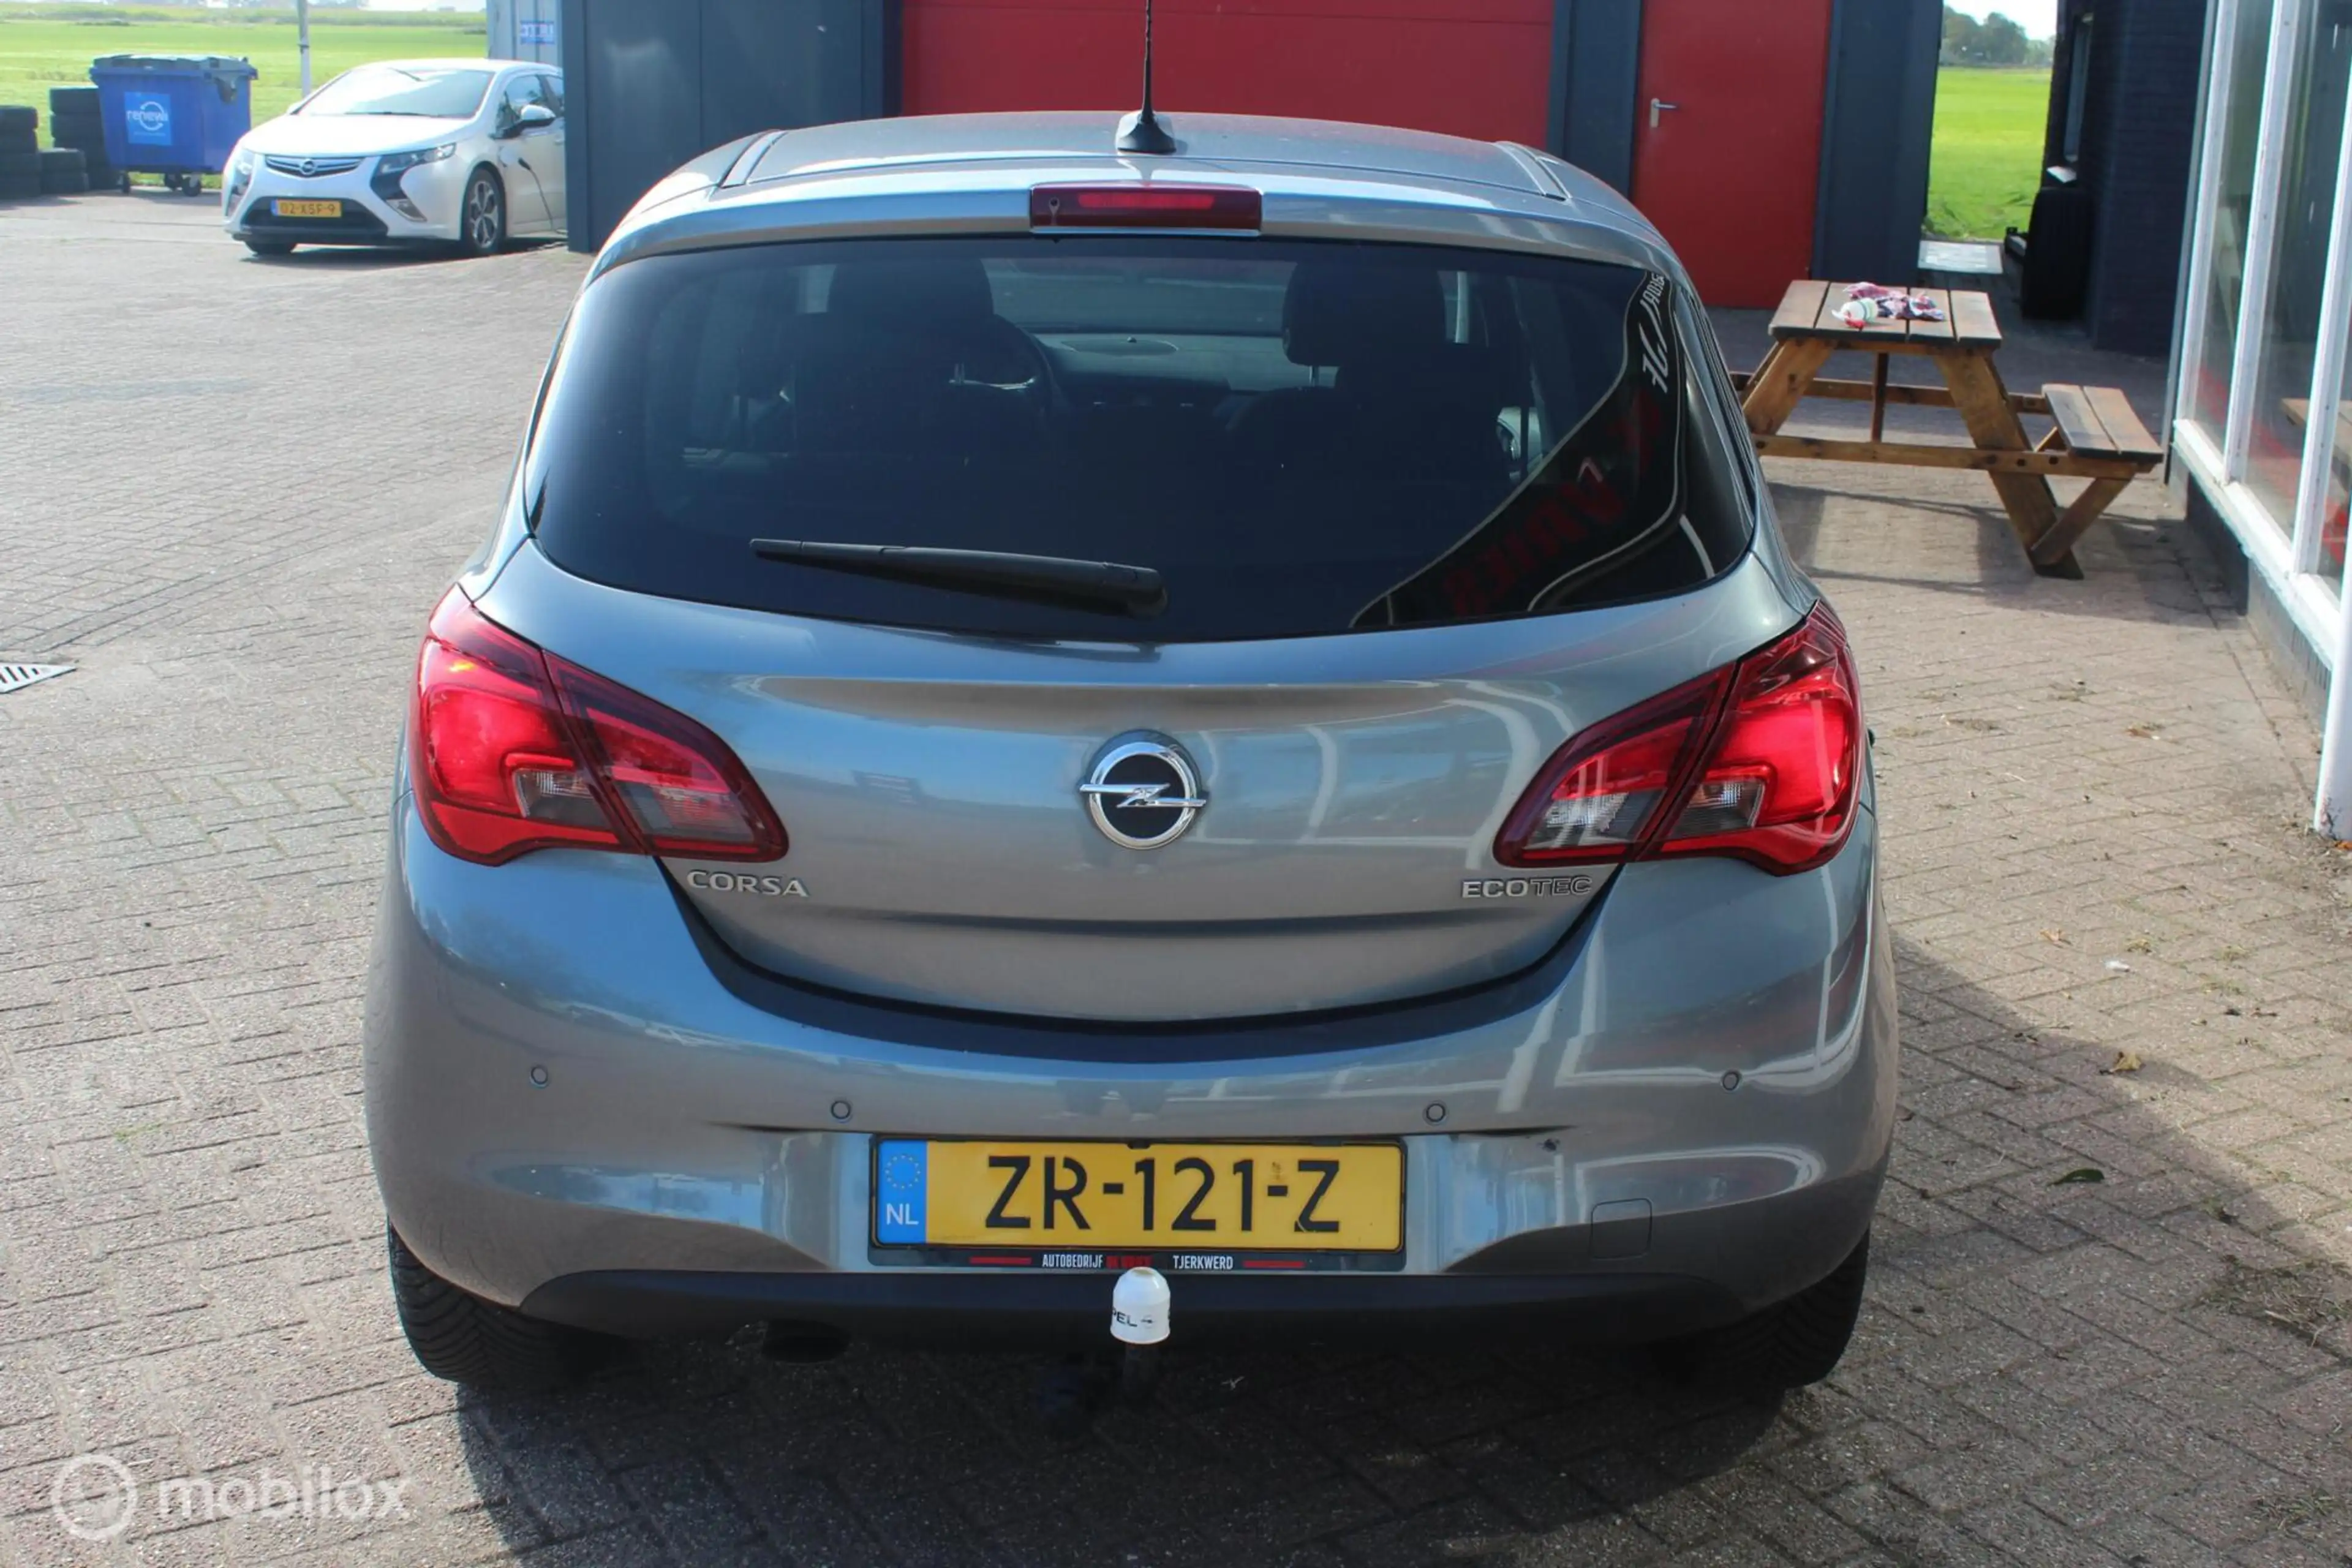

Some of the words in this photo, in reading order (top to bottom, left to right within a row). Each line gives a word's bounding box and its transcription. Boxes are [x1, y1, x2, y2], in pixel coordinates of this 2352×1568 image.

[687, 870, 809, 897] CORSA
[1461, 876, 1592, 899] ECOTEC
[984, 1155, 1340, 1232] ZR-121-Z
[886, 1203, 919, 1226] NL
[1042, 1254, 1103, 1268] AUTOBEDRIJF
[1173, 1254, 1234, 1270] TJERKWERD
